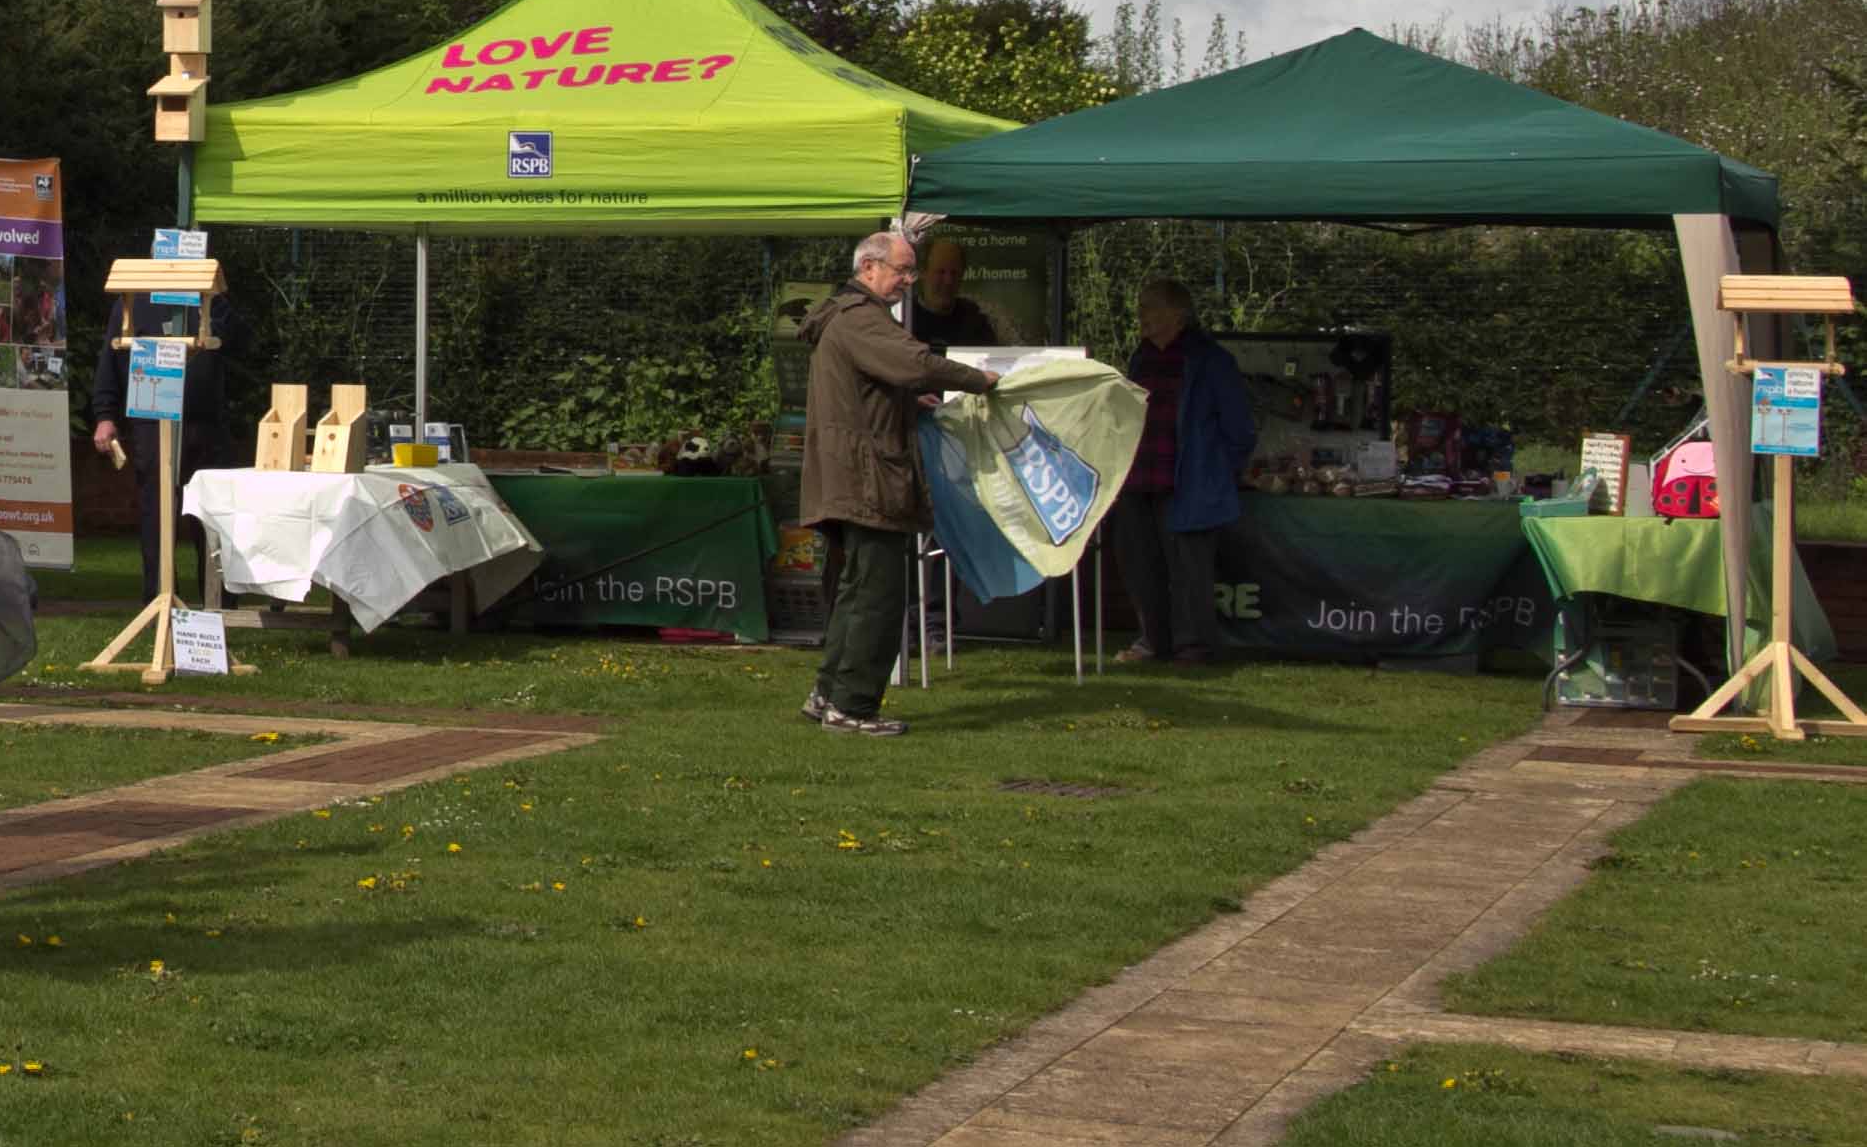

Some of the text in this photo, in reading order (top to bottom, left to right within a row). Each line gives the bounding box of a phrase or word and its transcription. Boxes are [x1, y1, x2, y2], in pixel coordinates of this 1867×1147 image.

[441, 26, 614, 69] LOVE
[424, 54, 736, 95] NATURE?
[511, 156, 550, 175] RSPB
[416, 189, 649, 205] a million voices for nature
[1015, 443, 1080, 531] RSPB
[595, 572, 645, 603] the
[655, 576, 737, 610] RSPB
[1307, 596, 1536, 635] Join the RPB
